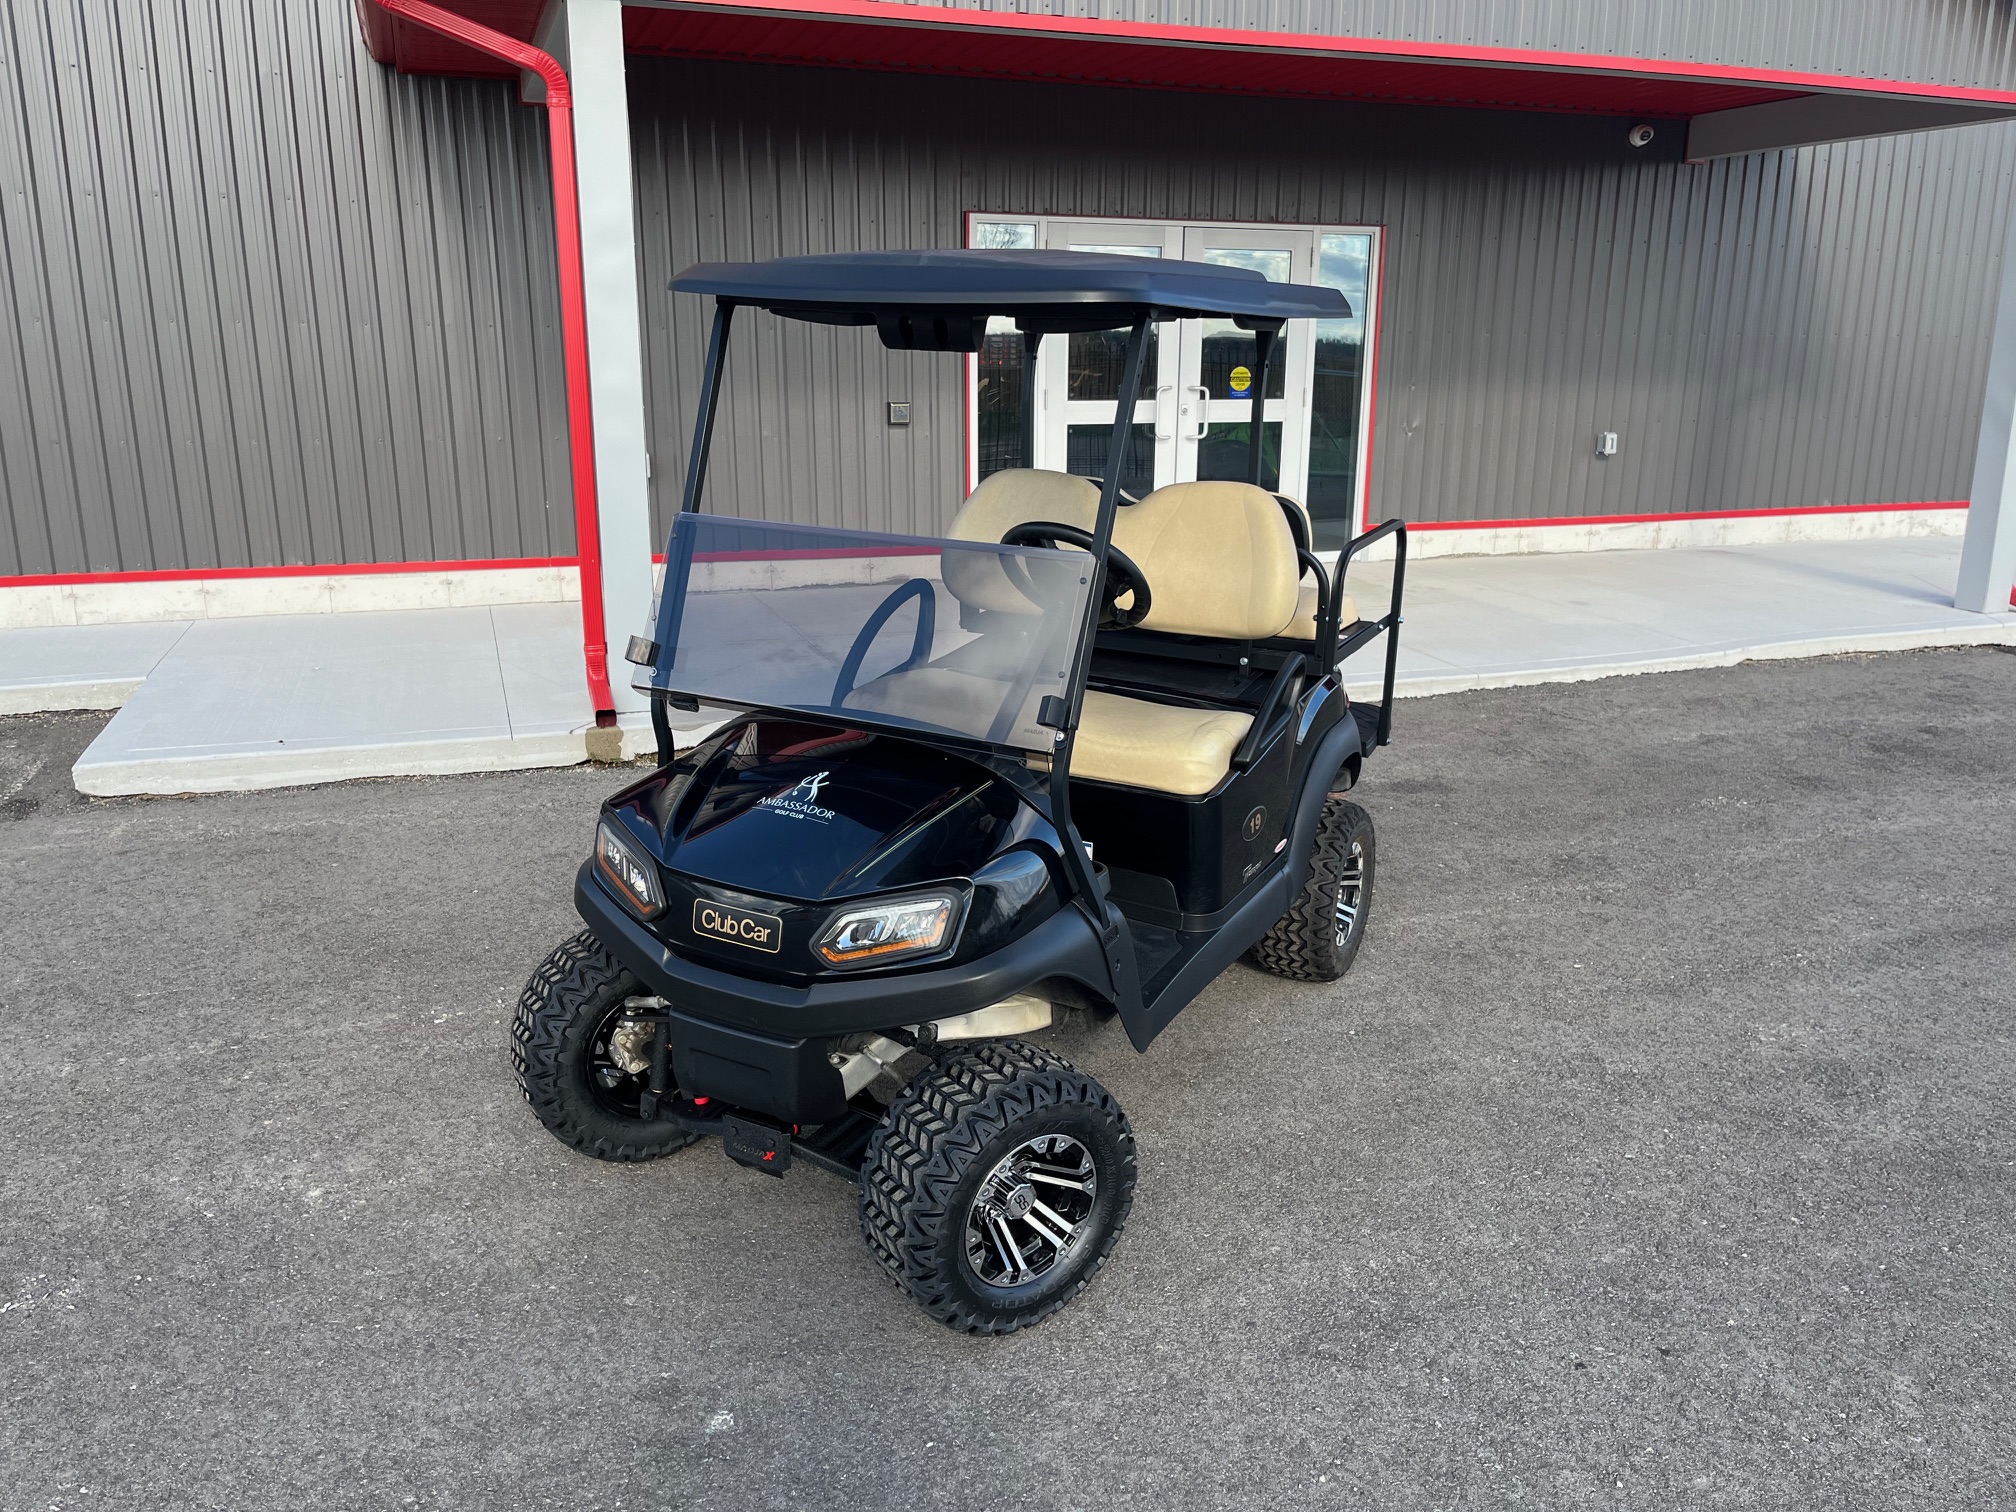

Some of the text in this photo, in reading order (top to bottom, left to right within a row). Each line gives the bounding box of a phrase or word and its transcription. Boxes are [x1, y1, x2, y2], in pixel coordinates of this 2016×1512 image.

[756, 796, 836, 820] AMBASSADOR
[1249, 813, 1262, 834] 19
[701, 909, 772, 943] Club Car
